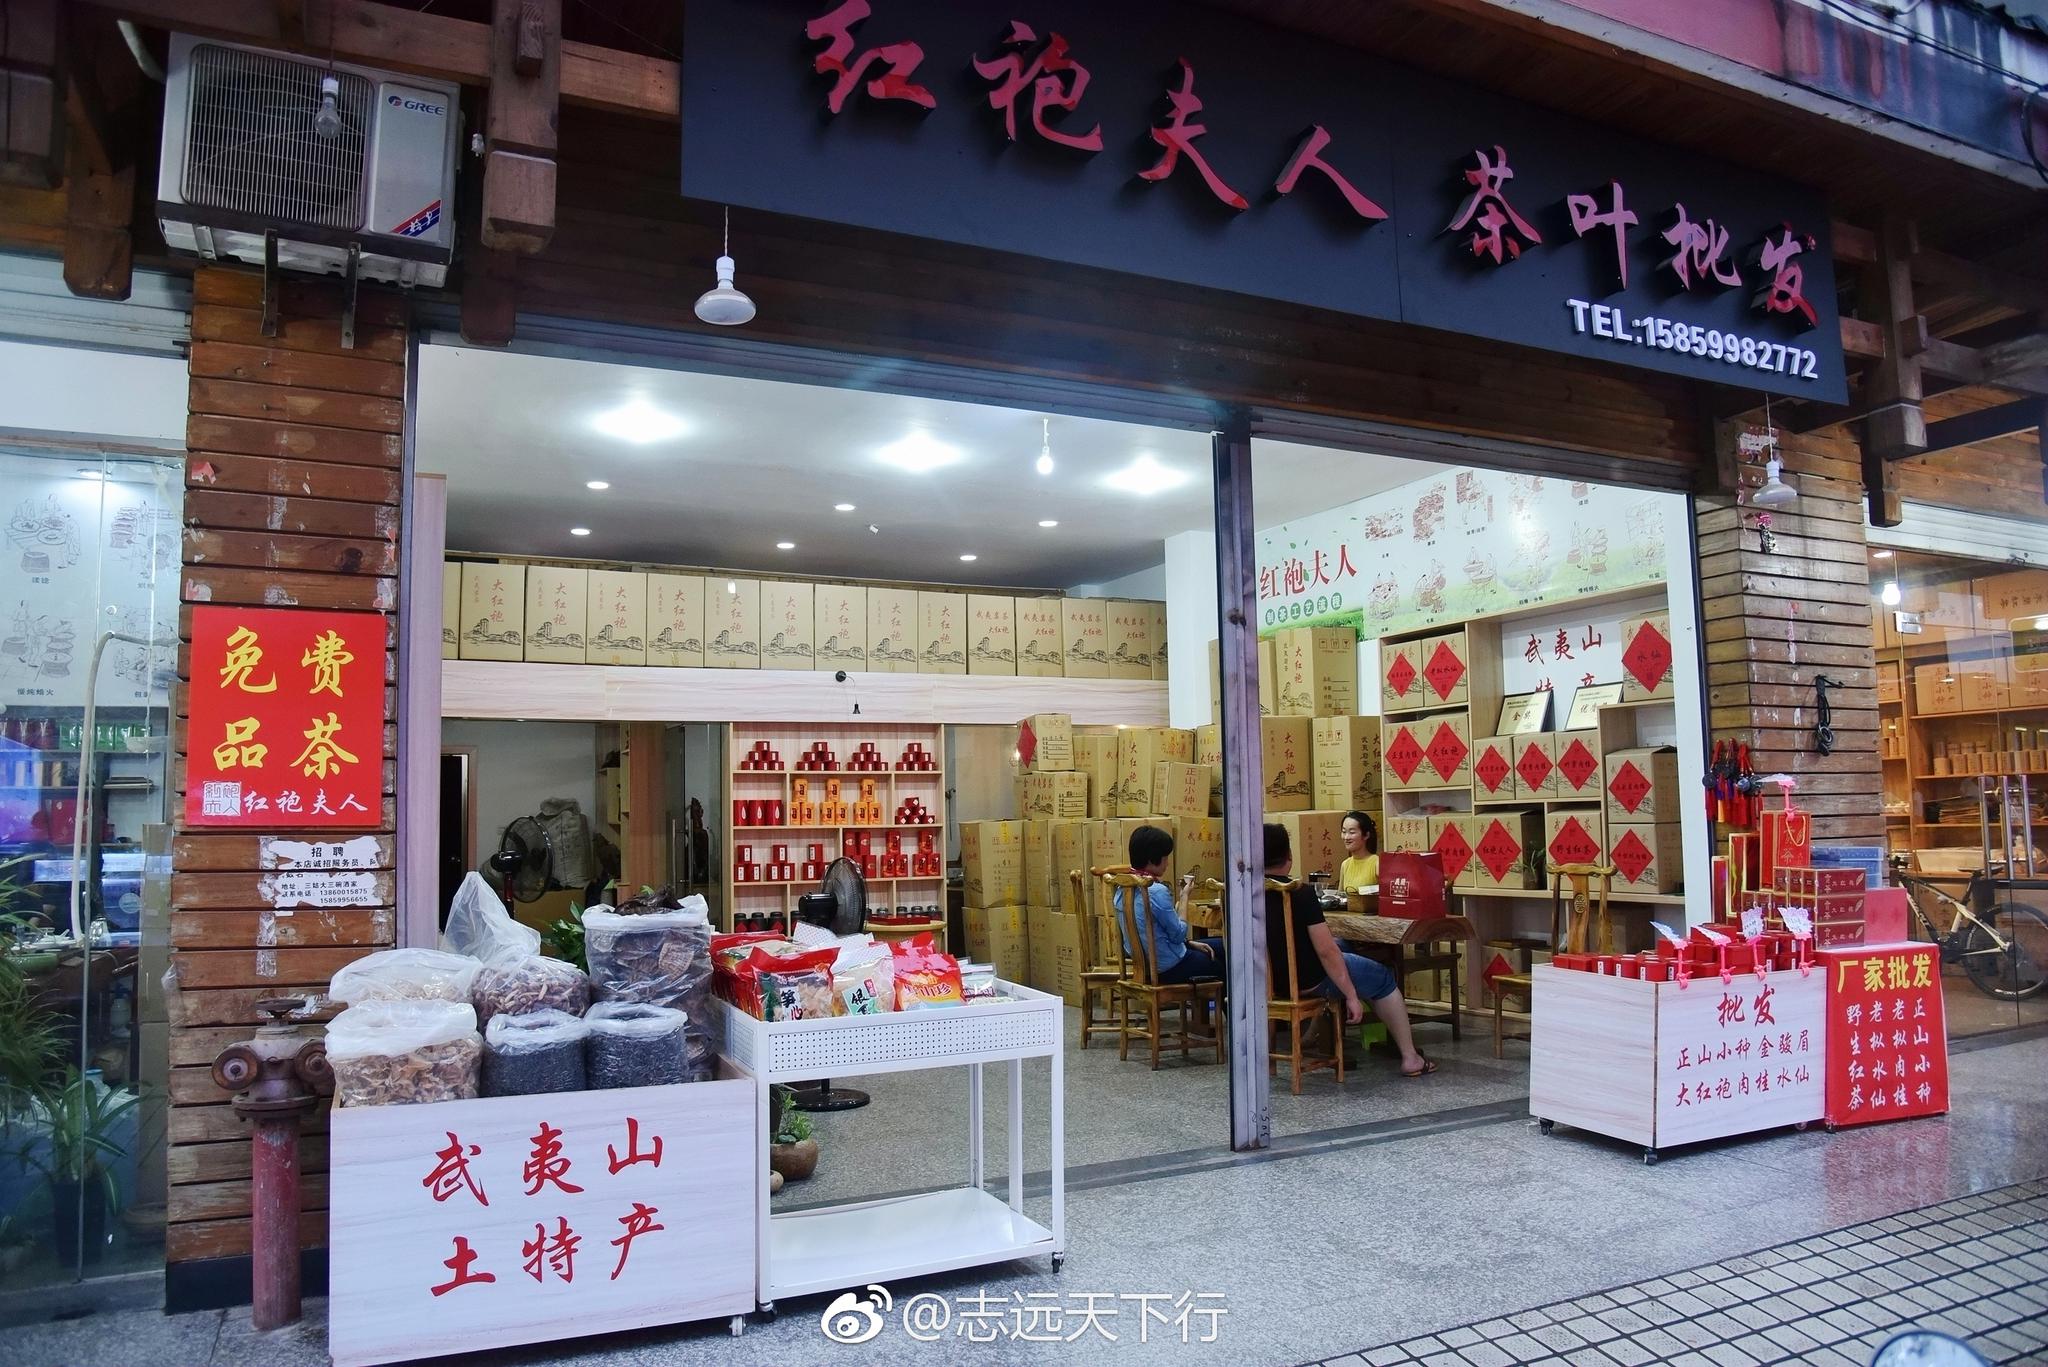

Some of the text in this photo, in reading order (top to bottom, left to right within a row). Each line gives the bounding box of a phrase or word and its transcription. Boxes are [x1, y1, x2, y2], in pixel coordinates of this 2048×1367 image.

[404, 100, 444, 116] GREE
[806, 0, 1819, 328] 红袍夫人 茶叶批发
[1567, 299, 1819, 381] TEL:15859982772
[1260, 544, 1358, 600] 红袍夫人
[490, 579, 504, 623] 大红袍
[553, 582, 568, 625] 大红袍
[614, 586, 627, 630] 大红袍
[672, 589, 686, 632] 大红袍
[730, 592, 744, 634] 大红袍
[785, 595, 797, 637] 大红袍
[838, 600, 850, 640] 大红袍
[939, 606, 951, 645] 大红袍
[1525, 625, 1602, 665] 武夷山
[220, 626, 355, 698] 免费
[1295, 646, 1303, 683] 大红袍
[213, 713, 360, 780] 品茶
[1129, 742, 1137, 783] 大红袍
[1284, 732, 1296, 775] 大红袍
[244, 789, 369, 816] 红袍夫人
[311, 846, 344, 858] 招聘
[1322, 828, 1334, 873] 大红袍
[1837, 953, 1932, 993] 厂家批发
[1717, 983, 1777, 1029] 批发
[1846, 1003, 1865, 1112] 野生红茶
[1868, 999, 1888, 1108] 老枞水仙
[1892, 997, 1908, 1107] 老枞肉桂
[1913, 995, 1931, 1107] 正山小种
[422, 1117, 664, 1207] 武夷山
[431, 1202, 665, 1298] 土特产
